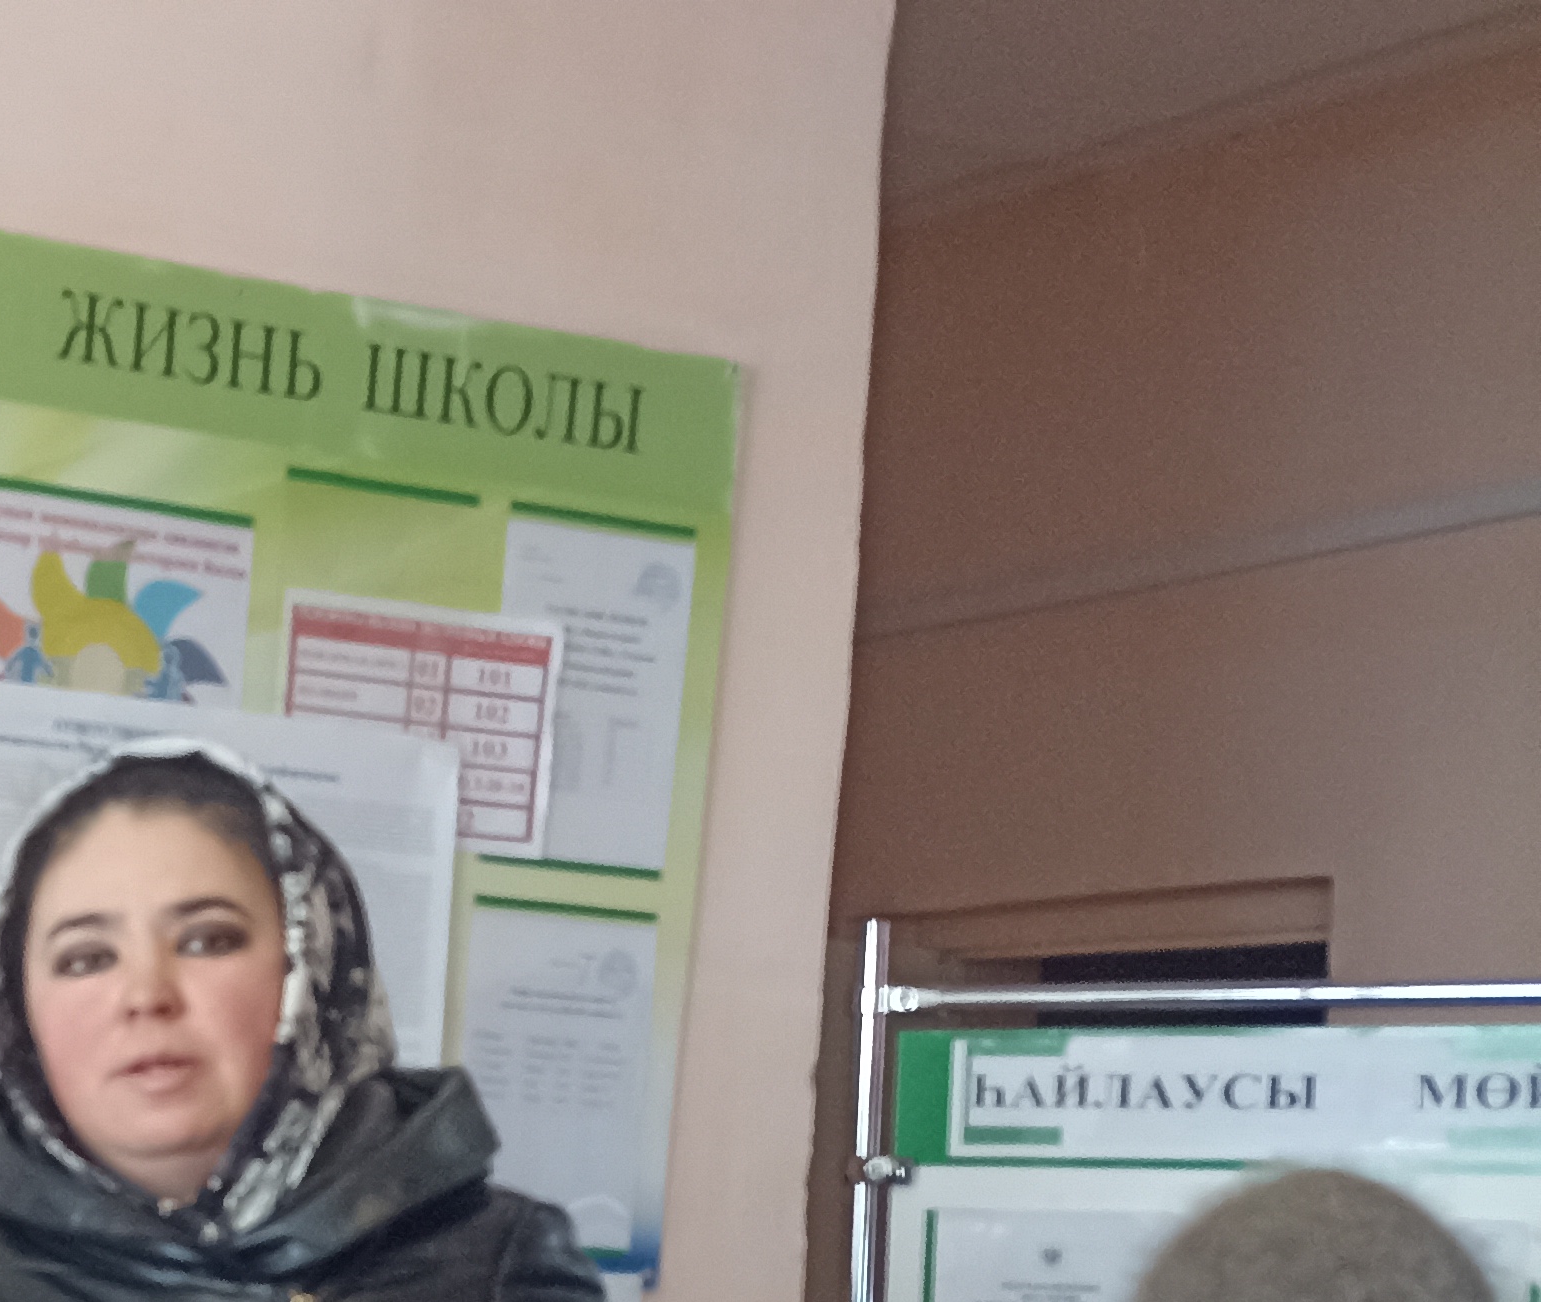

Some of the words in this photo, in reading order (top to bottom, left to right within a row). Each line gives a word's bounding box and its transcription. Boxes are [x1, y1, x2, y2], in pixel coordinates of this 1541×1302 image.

[57, 287, 324, 402] ЖИЗНЬ
[363, 342, 646, 456] ШКОЛЫ
[972, 1064, 1317, 1110] ҺАЙЛАУСЫ
